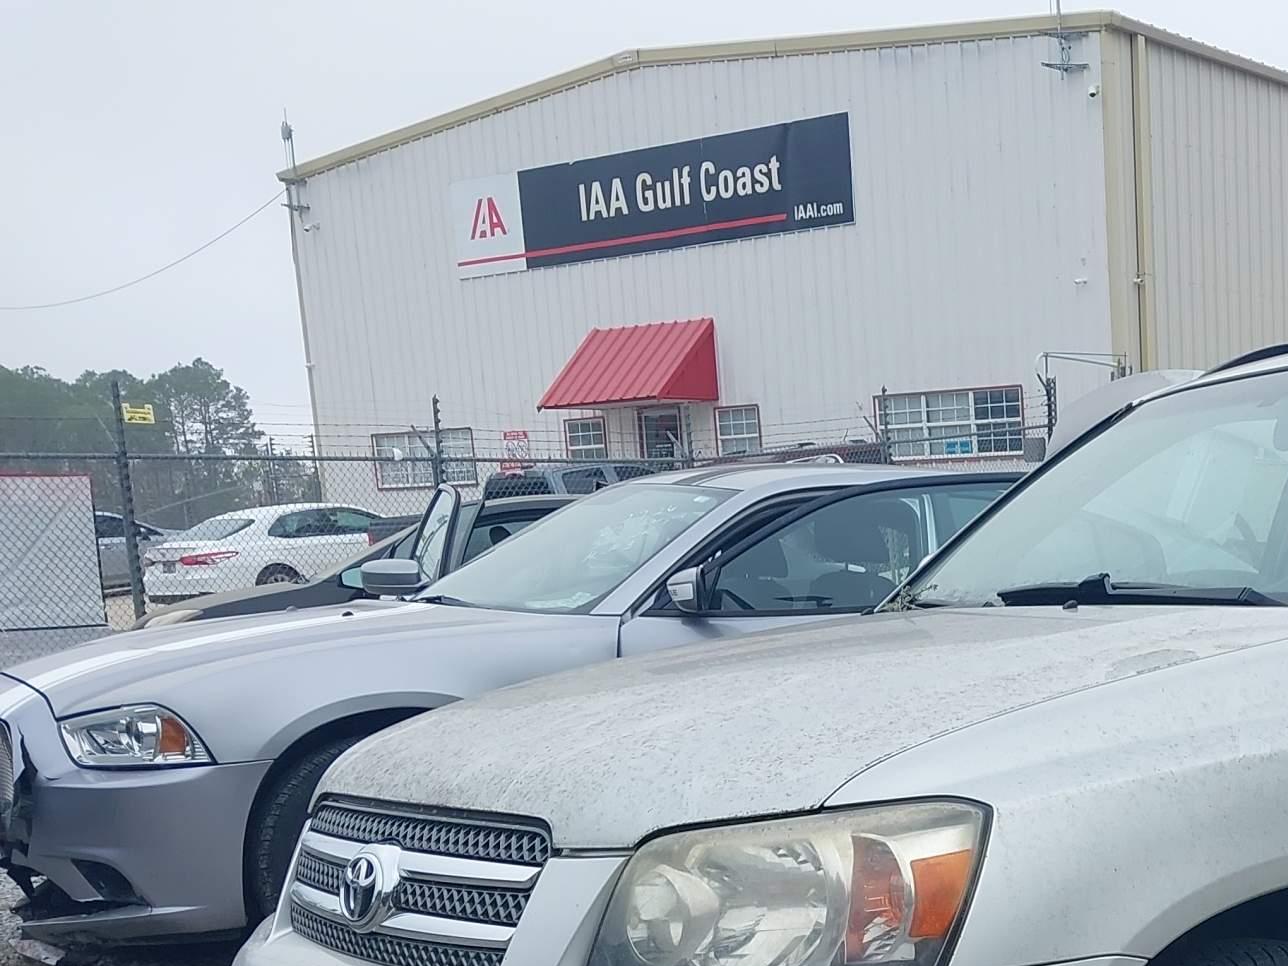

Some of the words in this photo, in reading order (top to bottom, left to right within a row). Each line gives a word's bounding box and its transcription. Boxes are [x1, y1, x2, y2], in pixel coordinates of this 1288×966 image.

[578, 177, 629, 222] IAA
[635, 165, 691, 212] Gulf
[700, 155, 782, 201] Coast
[794, 202, 844, 221] IAAI.com
